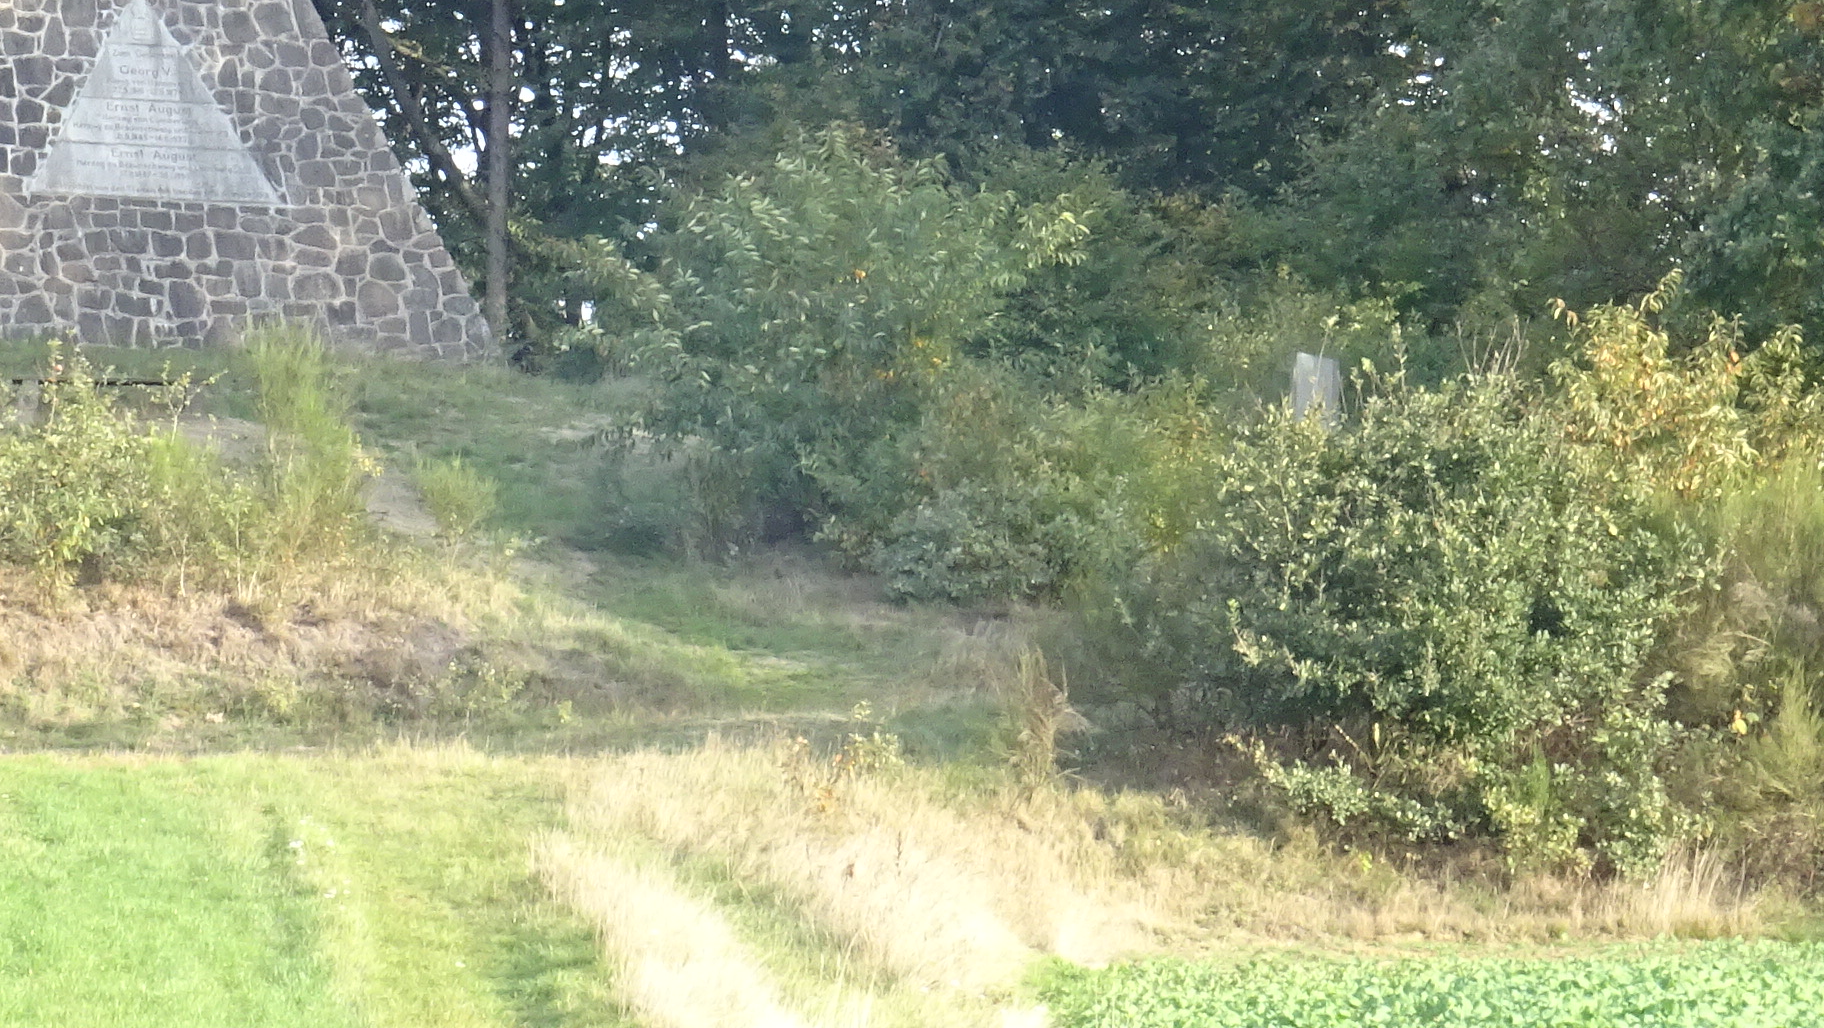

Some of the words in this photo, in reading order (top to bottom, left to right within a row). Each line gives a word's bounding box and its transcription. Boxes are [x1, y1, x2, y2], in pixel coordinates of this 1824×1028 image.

[119, 64, 159, 80] Georg
[106, 101, 139, 113] Ernst
[111, 148, 144, 159] Ernst
[153, 150, 196, 164] August
